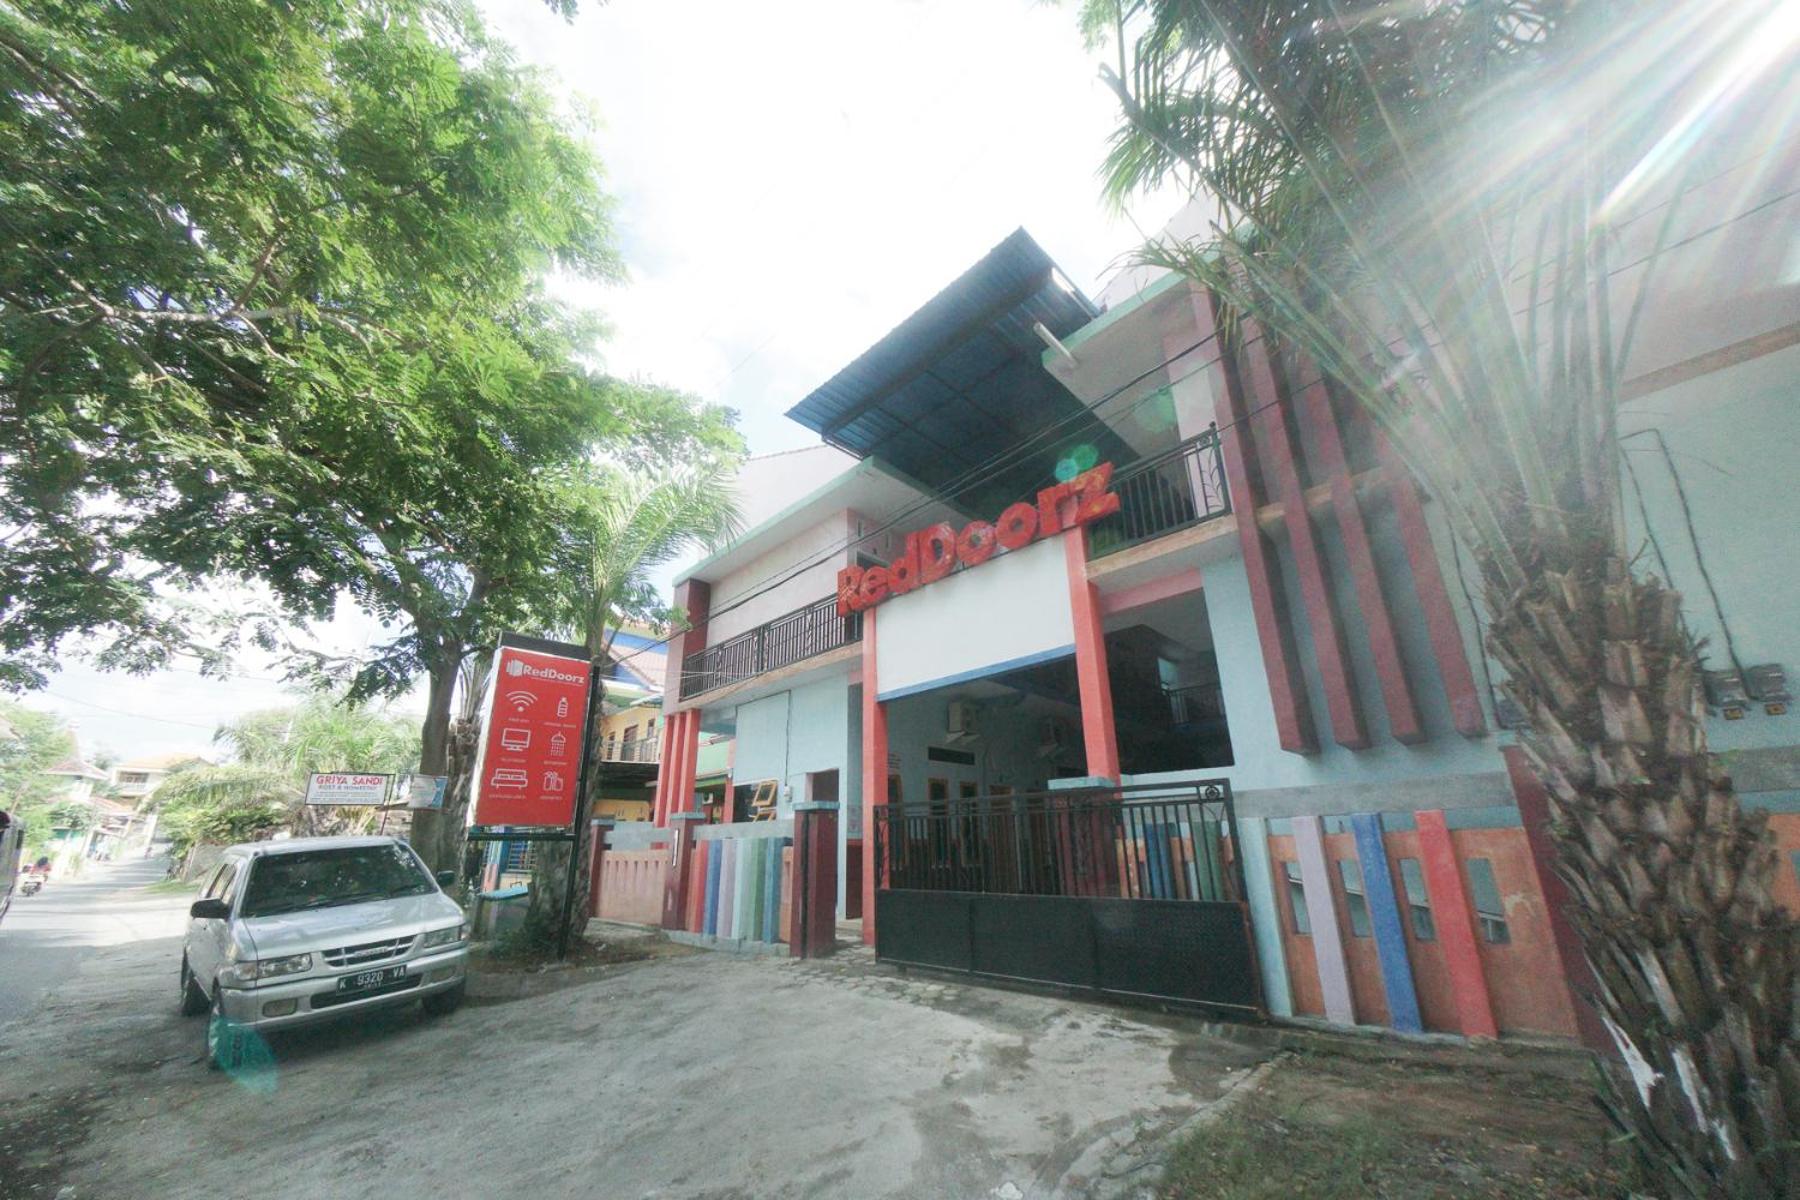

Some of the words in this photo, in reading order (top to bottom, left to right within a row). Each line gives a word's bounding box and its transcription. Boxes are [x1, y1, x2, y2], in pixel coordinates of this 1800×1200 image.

[837, 461, 1120, 617] RedDoorz
[523, 664, 585, 684] RedDoorz
[316, 775, 348, 785] GRIYA
[352, 776, 383, 785] SANDI
[340, 979, 346, 988] K
[357, 971, 384, 986] 9320
